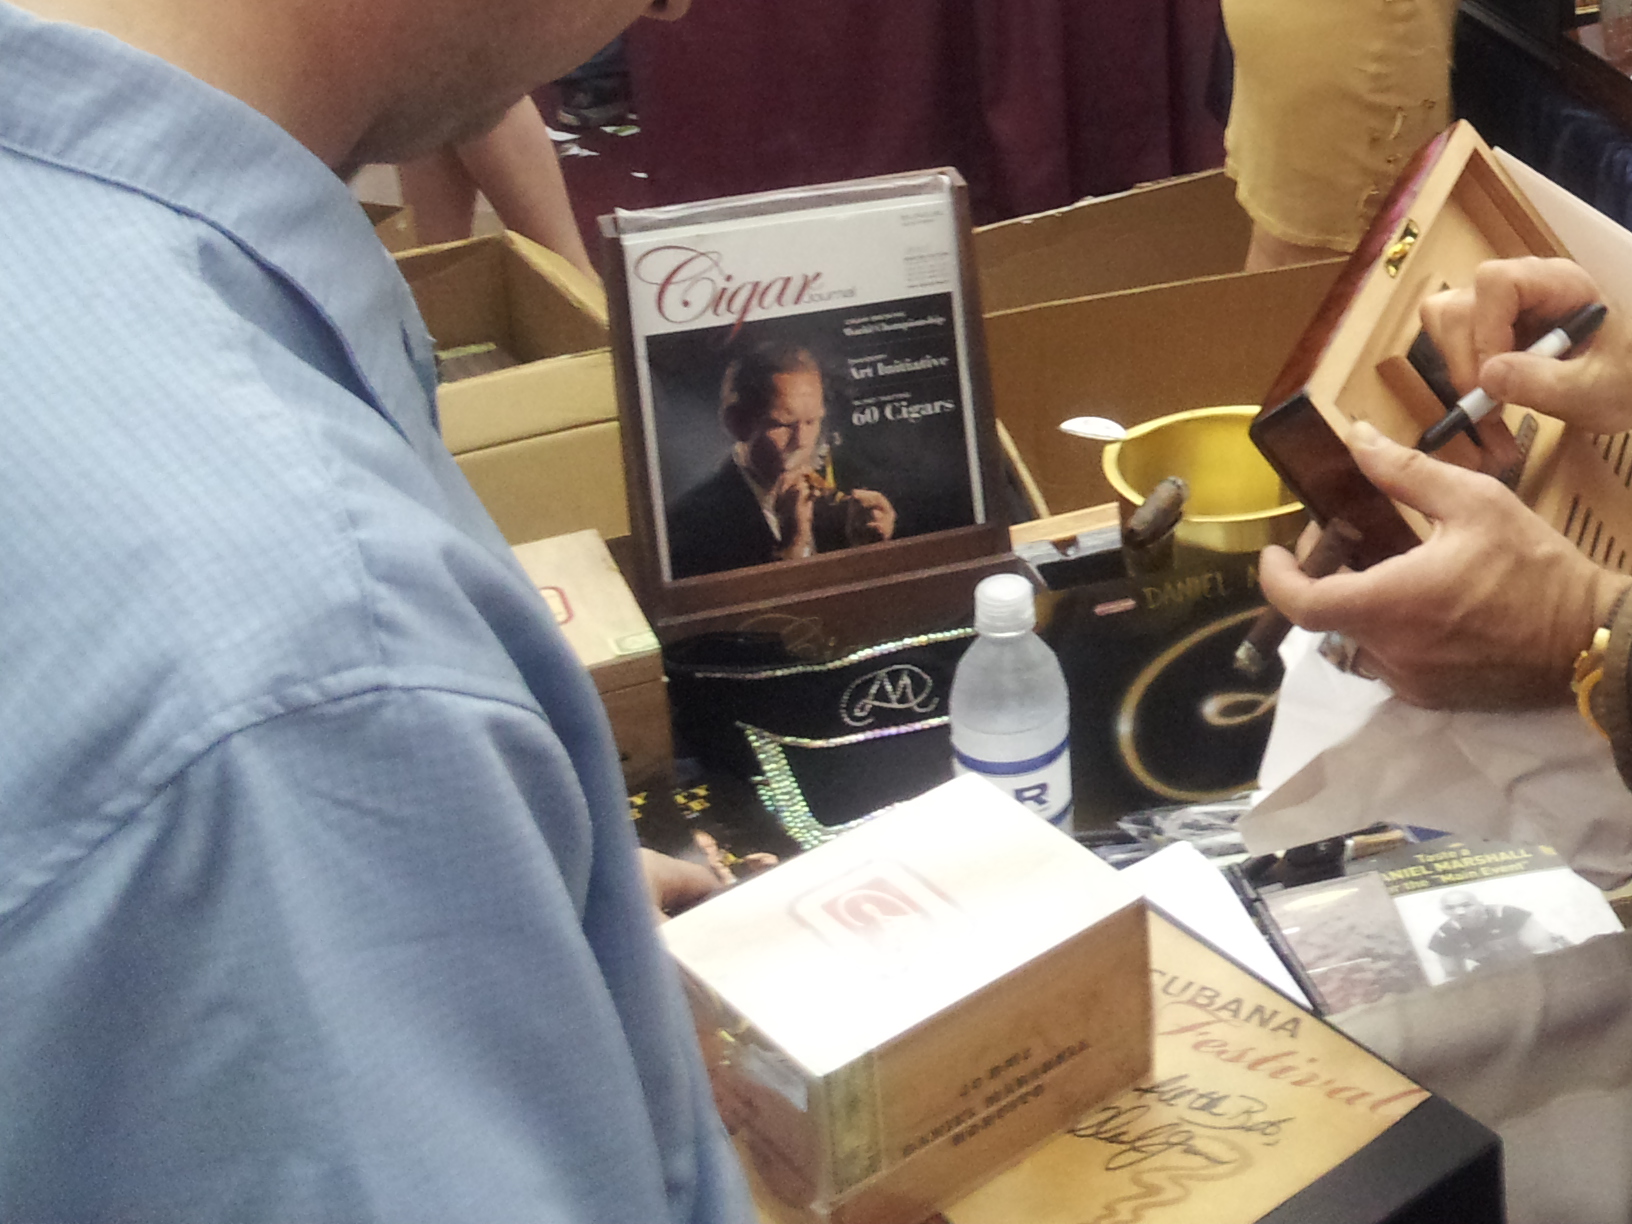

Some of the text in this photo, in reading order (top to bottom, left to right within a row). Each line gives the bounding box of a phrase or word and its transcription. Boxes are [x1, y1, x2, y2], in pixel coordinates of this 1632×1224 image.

[634, 245, 822, 342] Cigar
[851, 405, 880, 426] 60
[884, 399, 956, 423] Cigars
[1434, 848, 1533, 872] MARSHALL
